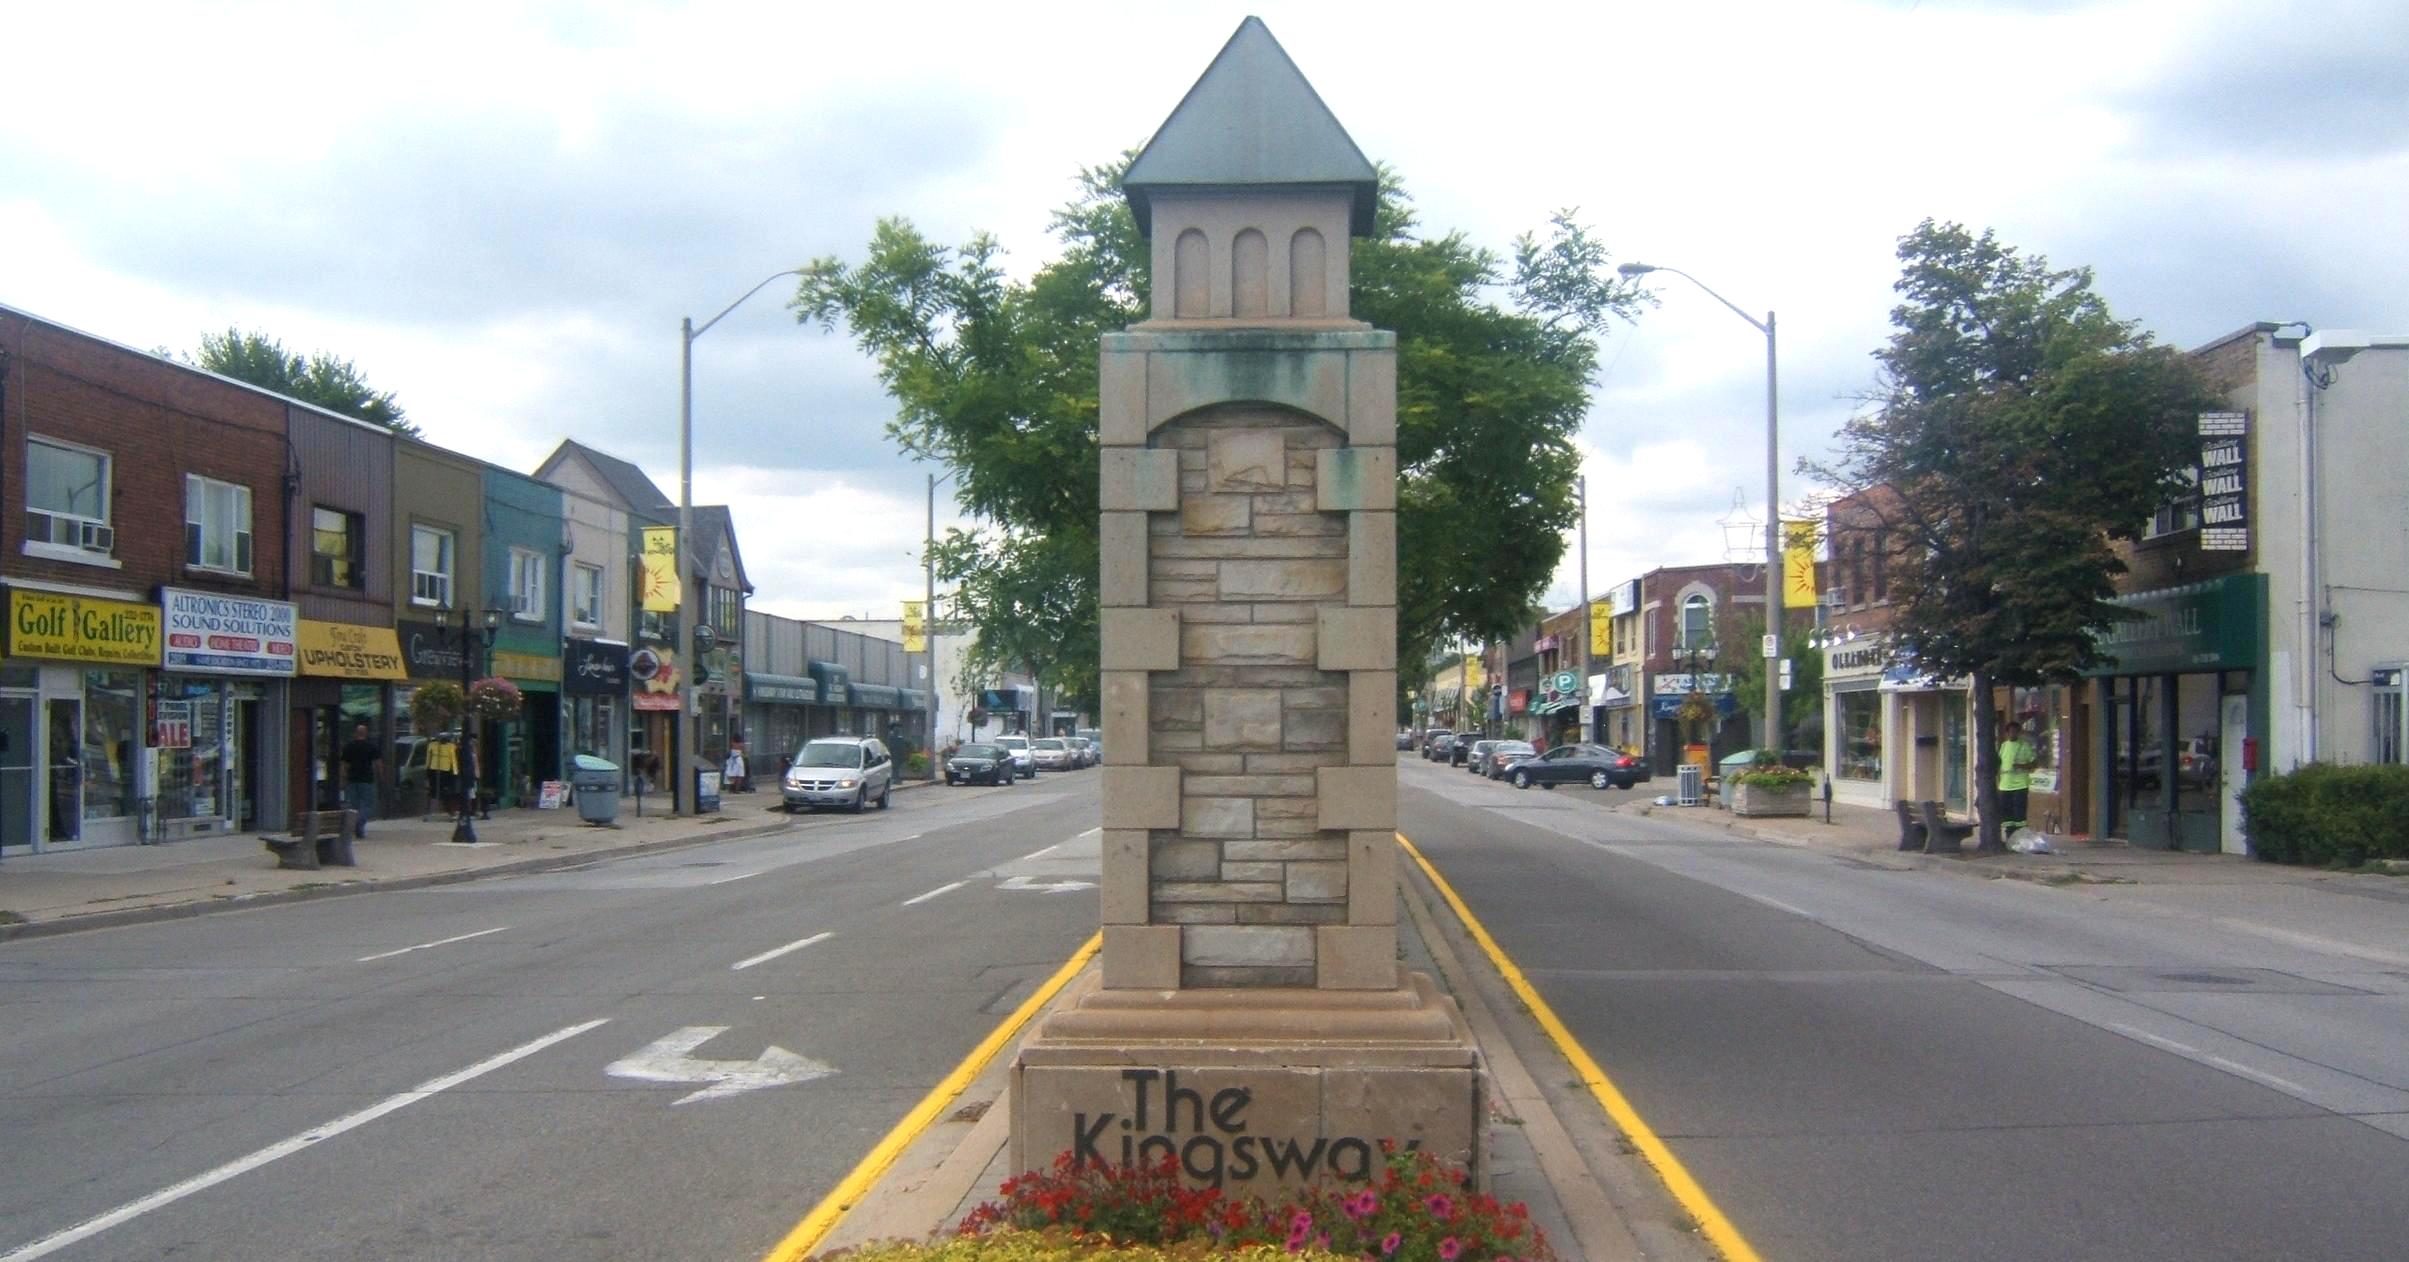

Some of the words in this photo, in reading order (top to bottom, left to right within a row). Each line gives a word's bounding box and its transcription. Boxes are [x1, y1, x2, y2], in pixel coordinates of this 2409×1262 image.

[2202, 449, 2242, 468] WALL
[2203, 477, 2243, 496] WALL
[2203, 506, 2243, 525] WALL
[172, 595, 230, 617] ALTRONICS
[231, 603, 267, 622] STEREO
[18, 602, 67, 637] Golf
[82, 609, 156, 649] Gallery
[172, 614, 221, 631] SOUND
[222, 618, 291, 637] SOLUTIONS
[303, 649, 400, 670] UPHOLSTERY
[157, 722, 189, 747] ALE
[1121, 1069, 1253, 1133] The
